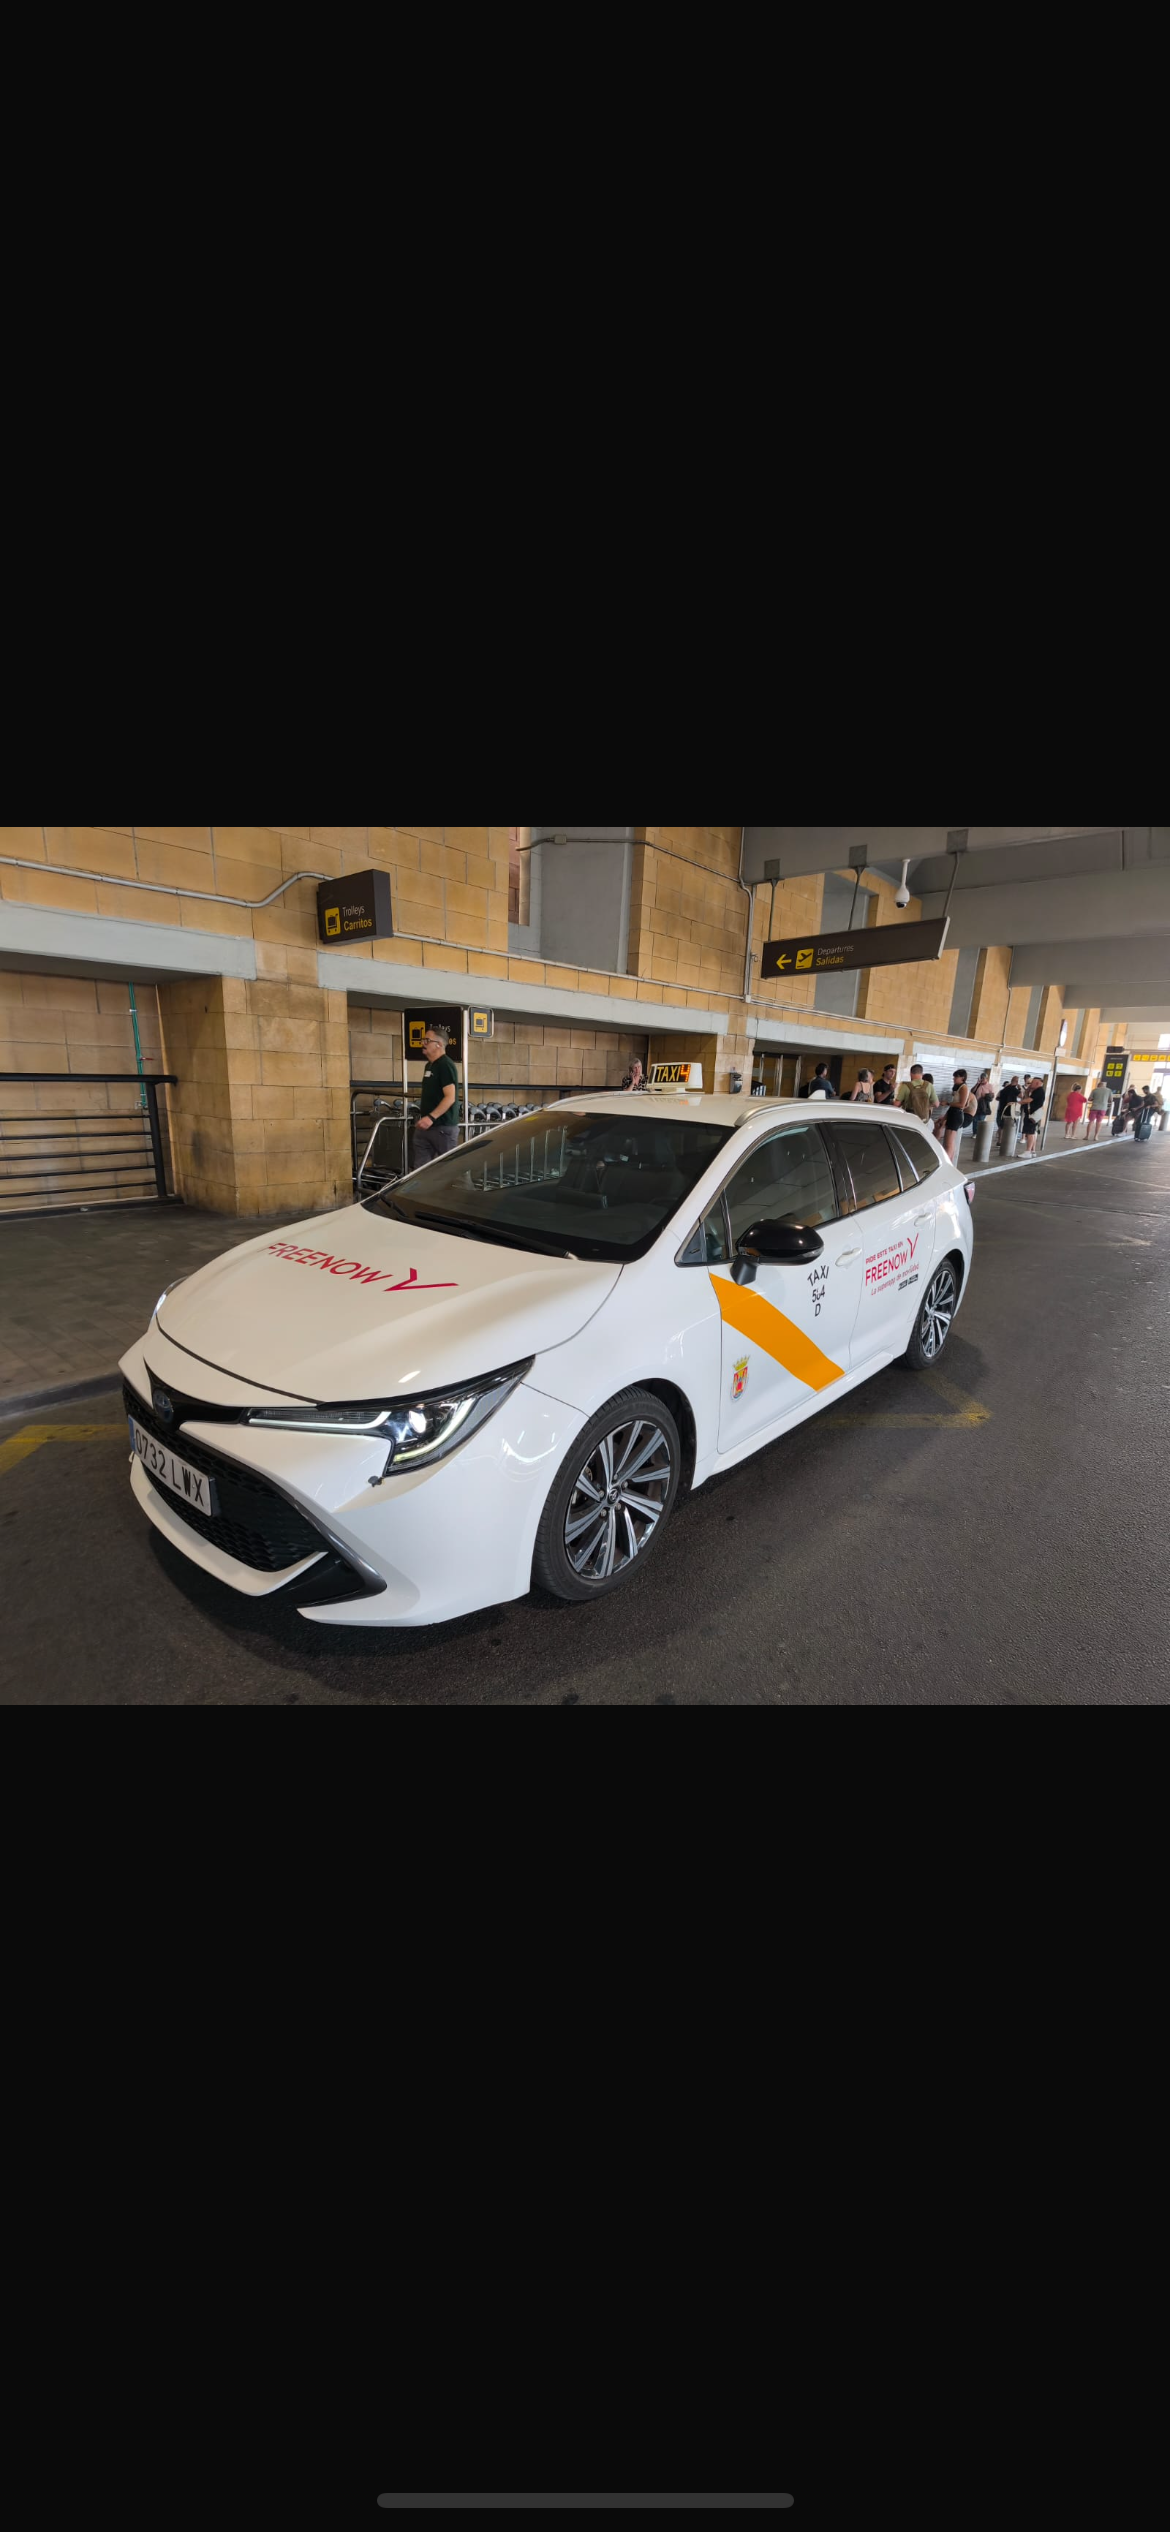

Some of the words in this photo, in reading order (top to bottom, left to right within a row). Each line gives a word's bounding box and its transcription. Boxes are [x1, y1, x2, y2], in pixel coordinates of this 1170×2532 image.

[342, 905, 365, 917] Trolleys
[343, 918, 373, 931] Carritos
[817, 944, 854, 956] Departures
[815, 955, 844, 966] Salidas
[657, 1065, 681, 1082] TAXI
[680, 1064, 691, 1082] 4
[268, 1242, 394, 1284] FREENOW
[865, 1254, 876, 1265] PIDE
[877, 1248, 888, 1259] ESTE
[807, 1265, 829, 1287] TAXI
[865, 1248, 909, 1287] FREENOW
[814, 1303, 822, 1317] D
[135, 1428, 167, 1480] 0732
[171, 1458, 205, 1507] LWX
